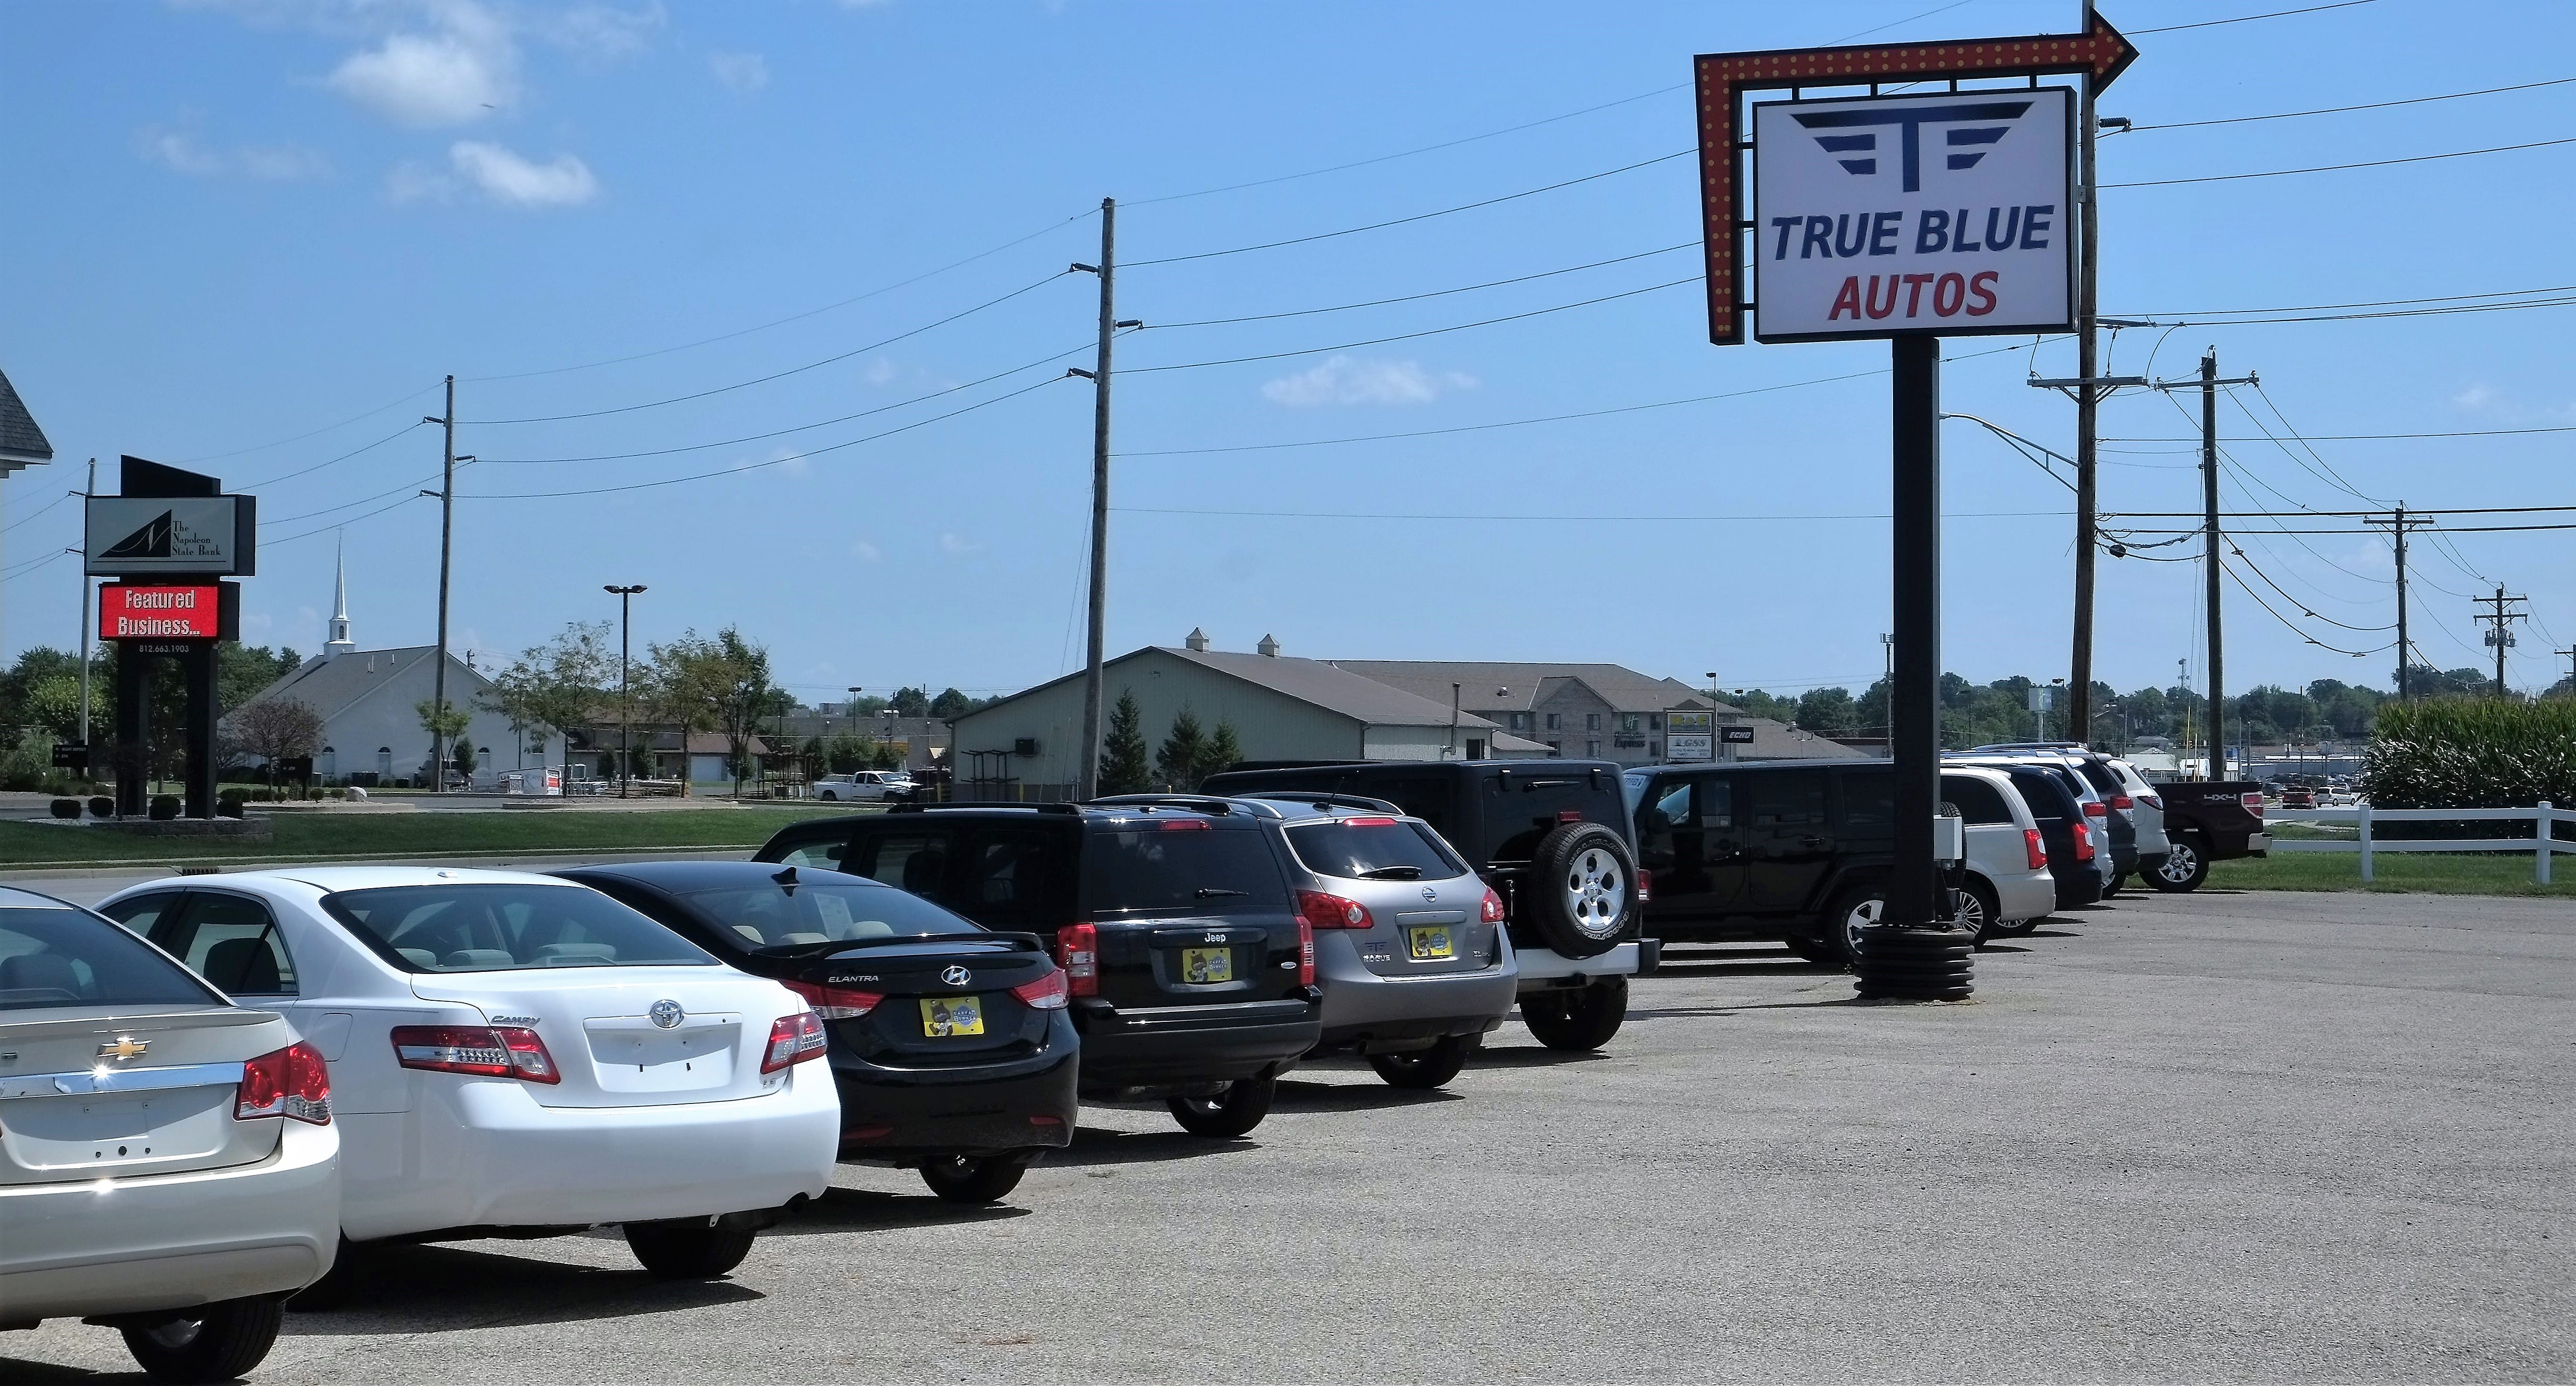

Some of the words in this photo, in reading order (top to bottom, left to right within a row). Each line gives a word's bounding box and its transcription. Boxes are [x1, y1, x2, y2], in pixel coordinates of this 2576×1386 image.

[1771, 211, 1903, 260] TRUE
[1916, 205, 2055, 254] BLUE
[1828, 271, 1999, 321] AUTOS
[173, 520, 189, 531] The
[174, 532, 210, 546] Napoleon
[172, 545, 194, 556] State
[198, 544, 221, 556] Bank
[126, 589, 195, 609] Featured
[118, 616, 200, 636] Business...
[1204, 932, 1226, 943] Jeep
[828, 975, 879, 983] ELANTRA
